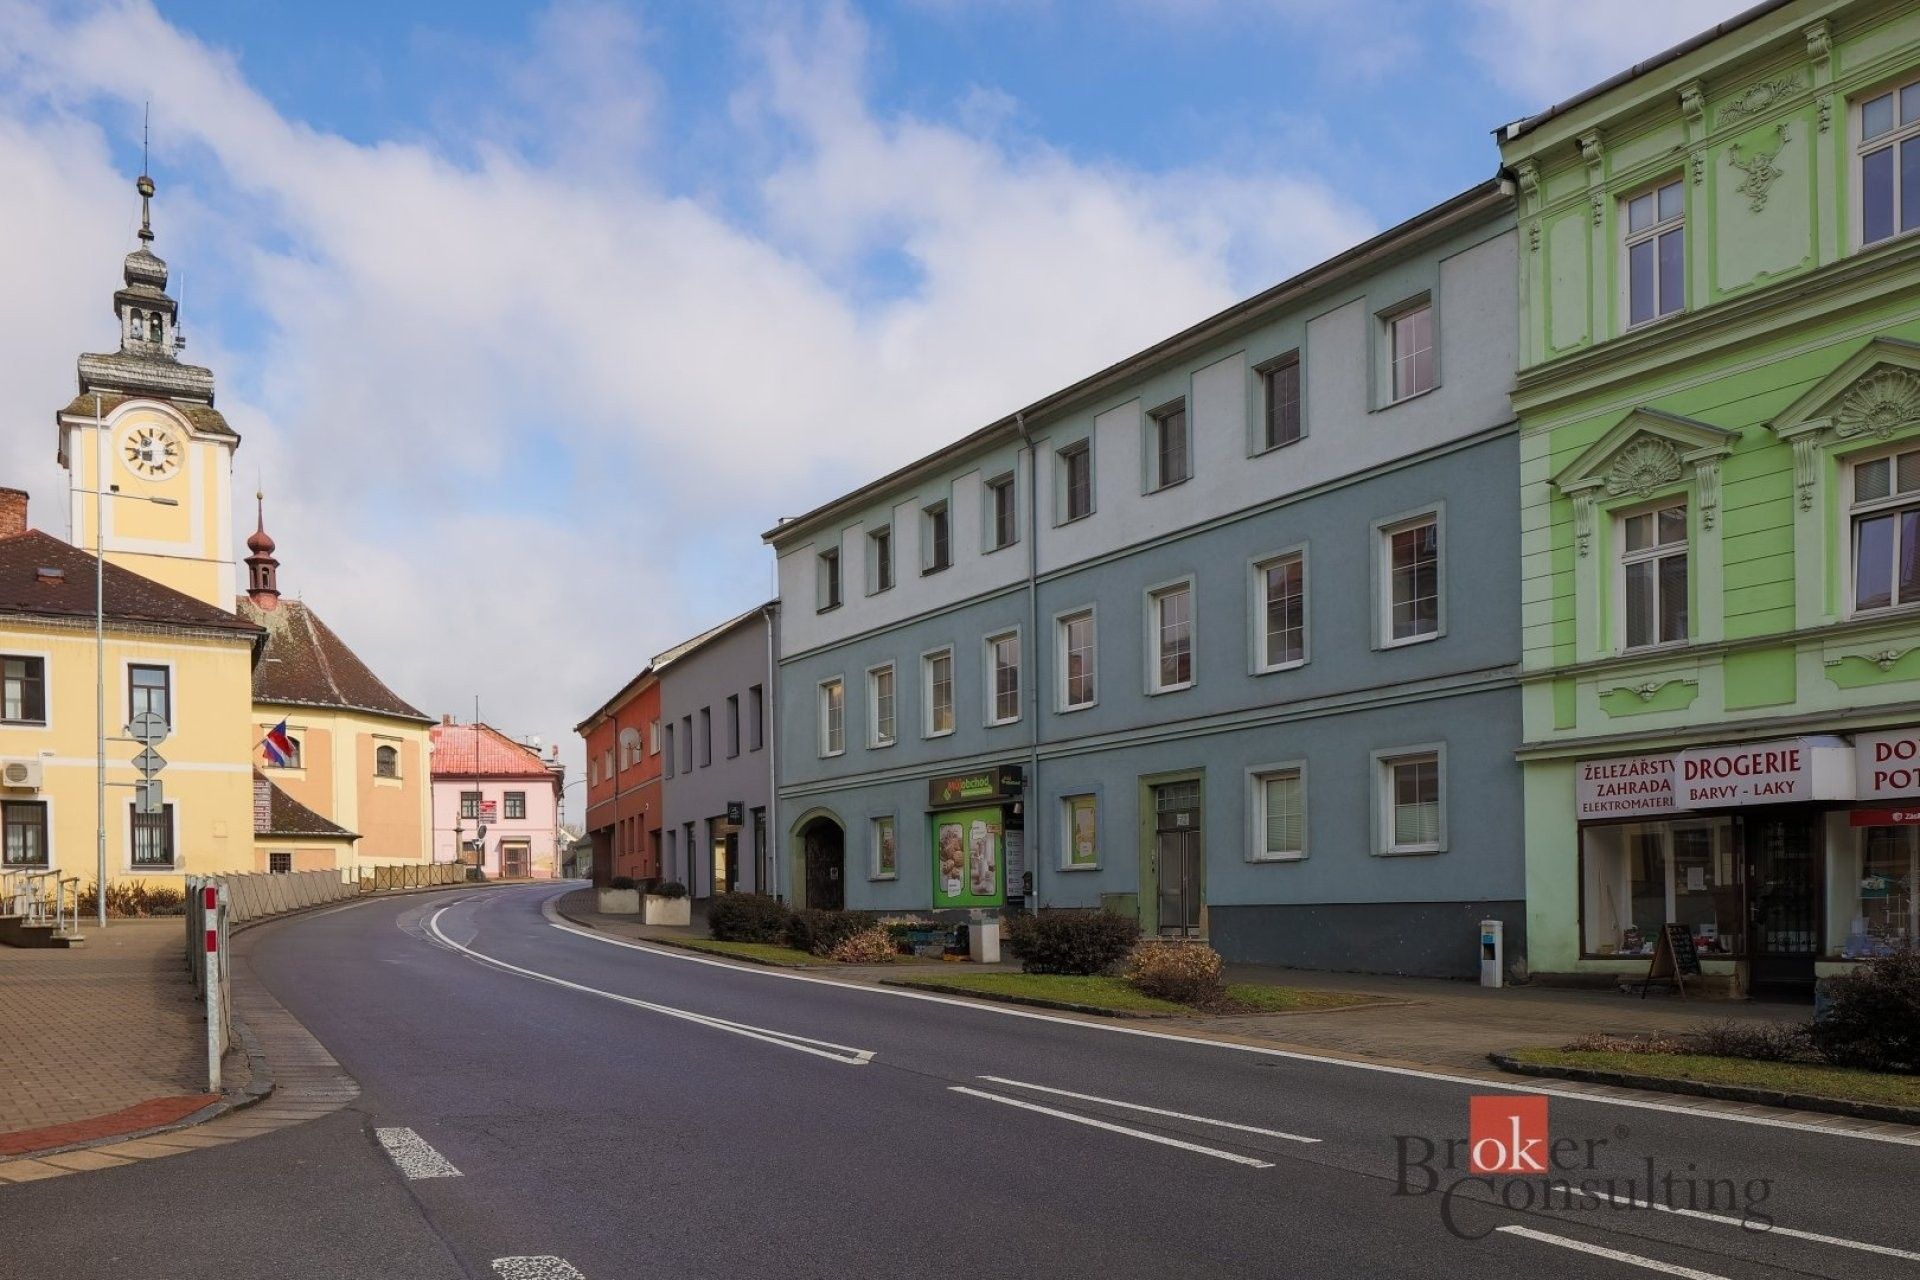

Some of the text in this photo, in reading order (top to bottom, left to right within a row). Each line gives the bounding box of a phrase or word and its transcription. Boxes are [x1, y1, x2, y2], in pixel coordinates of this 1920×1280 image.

[1875, 739, 1920, 762] DO
[1683, 749, 1802, 781] DROGERIE
[1597, 778, 1672, 797] ZAHRADA
[1689, 785, 1738, 801] BARVY
[1753, 780, 1795, 796] LAKY
[1582, 796, 1676, 813] ELEKTROMATERI
